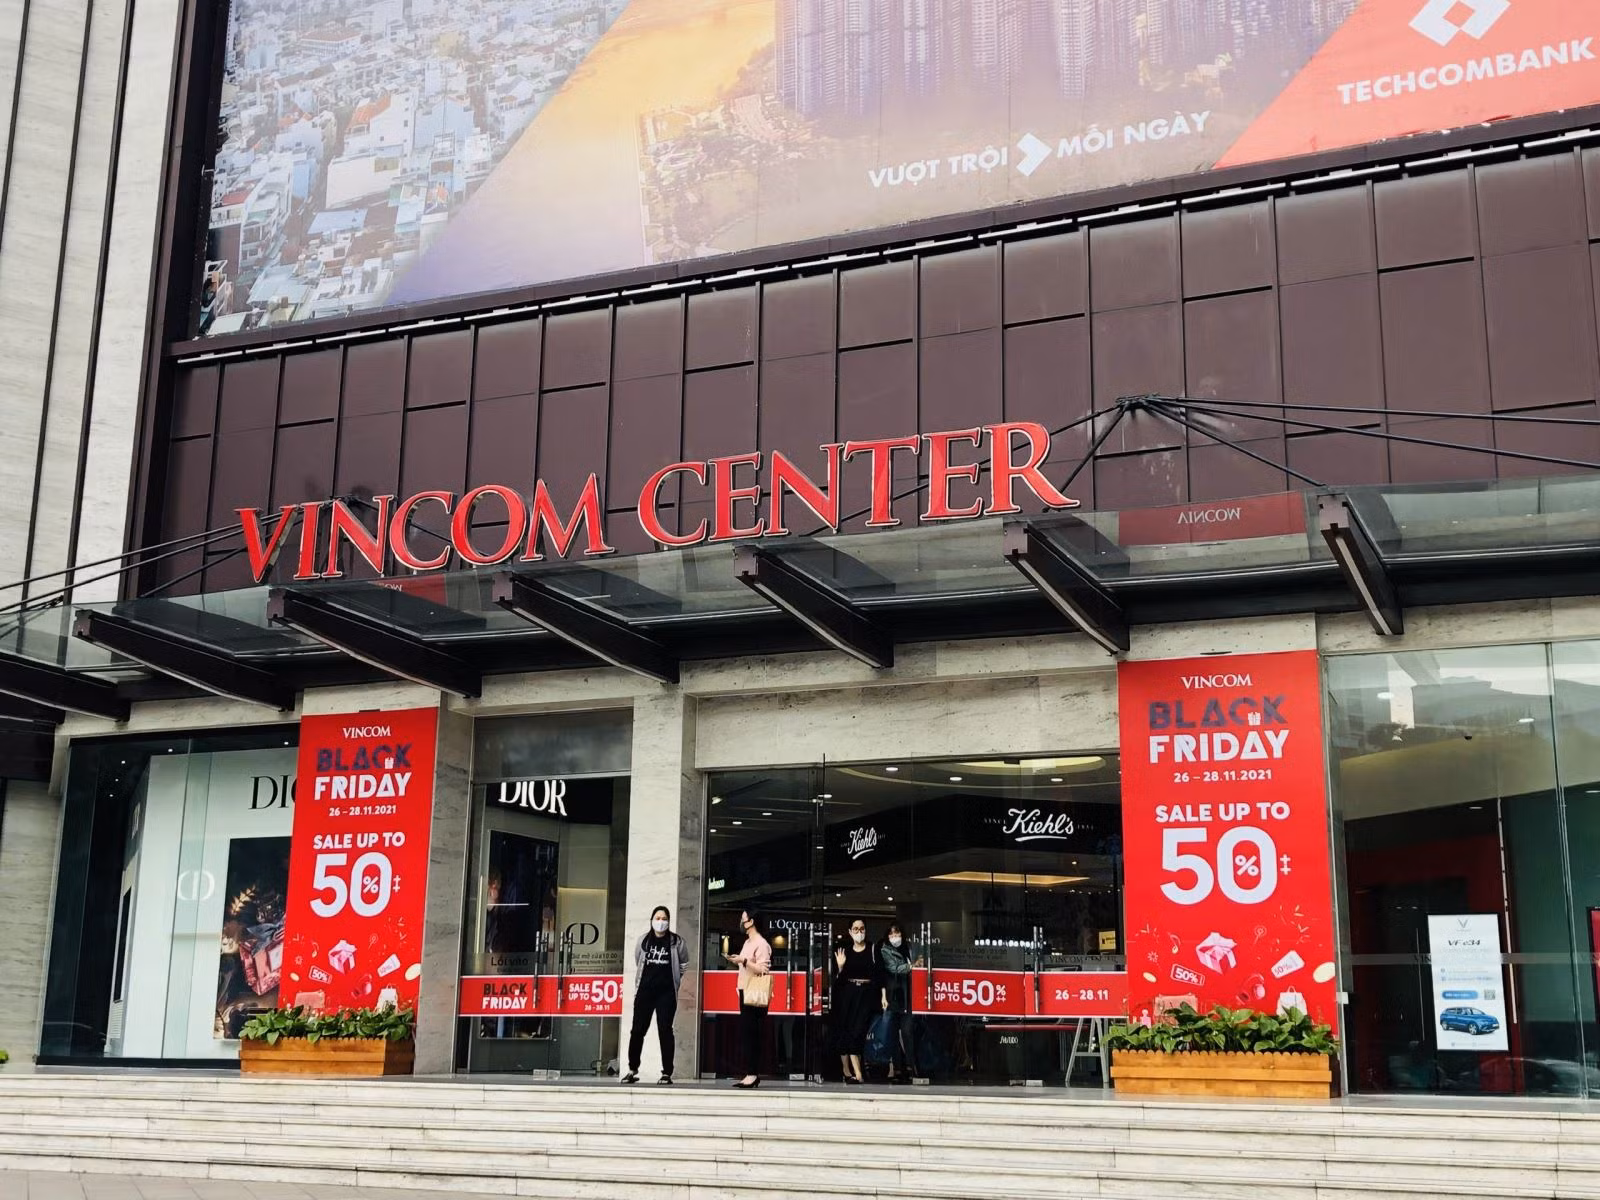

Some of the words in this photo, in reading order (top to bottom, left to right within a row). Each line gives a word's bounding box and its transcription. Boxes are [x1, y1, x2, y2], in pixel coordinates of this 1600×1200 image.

[1337, 37, 1595, 105] TECHCOMBANK
[868, 160, 940, 187] VƯỢT
[948, 145, 1008, 173] TRỘI
[1124, 110, 1212, 145] NGÀY
[234, 472, 615, 582] VINCOM
[637, 420, 1081, 546] CENTER
[1181, 674, 1253, 689] VINCOM
[1148, 694, 1288, 730] BLACK
[343, 726, 391, 739] VINCOM
[1149, 729, 1290, 764] FRIDAY
[317, 743, 412, 773] BLACK
[1174, 772, 1189, 783] 26
[1203, 769, 1272, 782] 28.11.2021
[248, 774, 297, 810] DI
[314, 772, 412, 800] FRIDAY
[499, 780, 568, 816] DIOR
[329, 807, 340, 817] 26
[349, 805, 397, 816] 28.11.2021
[1155, 804, 1213, 823] SALE
[1218, 802, 1251, 821] UP
[1256, 801, 1291, 821] TO
[1003, 808, 1074, 834] Kiehl's
[313, 834, 353, 849] SALE
[357, 833, 379, 848] UP
[383, 831, 406, 847] TO
[848, 827, 877, 854] Kiehl's
[311, 968, 329, 982] 50%
[1174, 967, 1198, 984] 50%
[484, 983, 527, 995] BLACK
[569, 983, 591, 992] SALE
[934, 982, 960, 993] SALE
[1055, 990, 1069, 1000] 26
[1080, 989, 1109, 1000] 28.11
[482, 996, 528, 1010] FRIDAY
[568, 993, 578, 1001] UP
[579, 993, 590, 1001] TO
[934, 993, 946, 1002] UP
[947, 993, 960, 1002] TO
